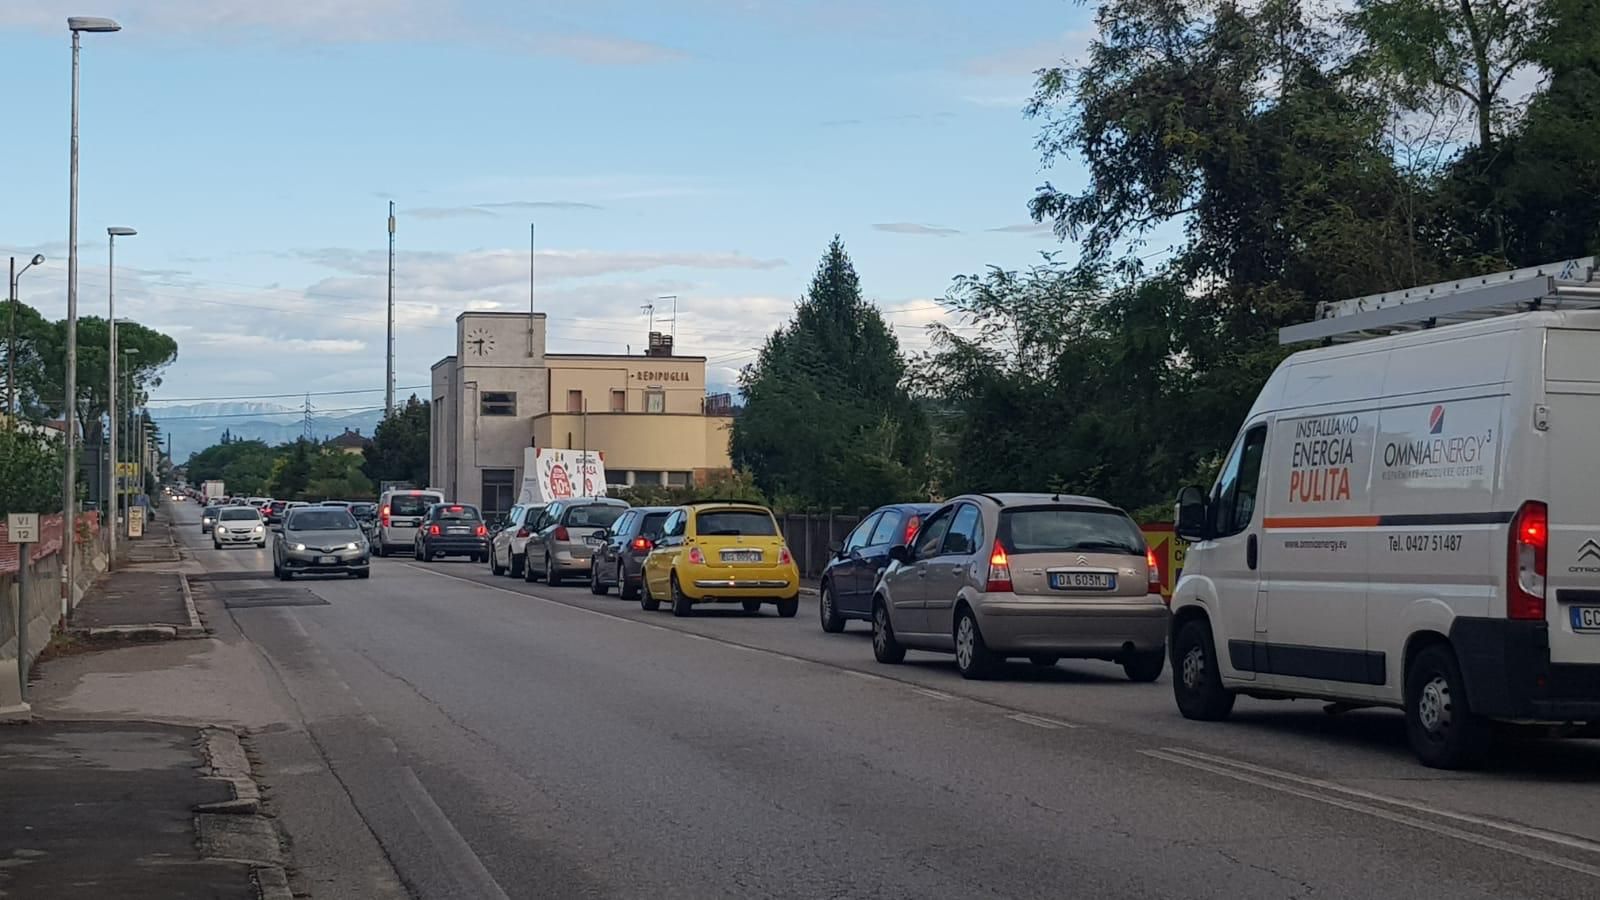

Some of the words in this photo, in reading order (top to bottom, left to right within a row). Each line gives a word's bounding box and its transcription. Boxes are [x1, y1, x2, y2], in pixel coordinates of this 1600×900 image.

[637, 371, 689, 381] REDIPUGLIA
[1296, 416, 1359, 438] INSTALLIAMO
[1292, 438, 1353, 468] ENERGIA
[1289, 467, 1350, 503] PULITA
[17, 516, 29, 525] VI
[17, 530, 29, 539] 12
[1388, 535, 1404, 551] Tel.
[1405, 535, 1429, 551] 0427
[1431, 534, 1462, 551] 51487
